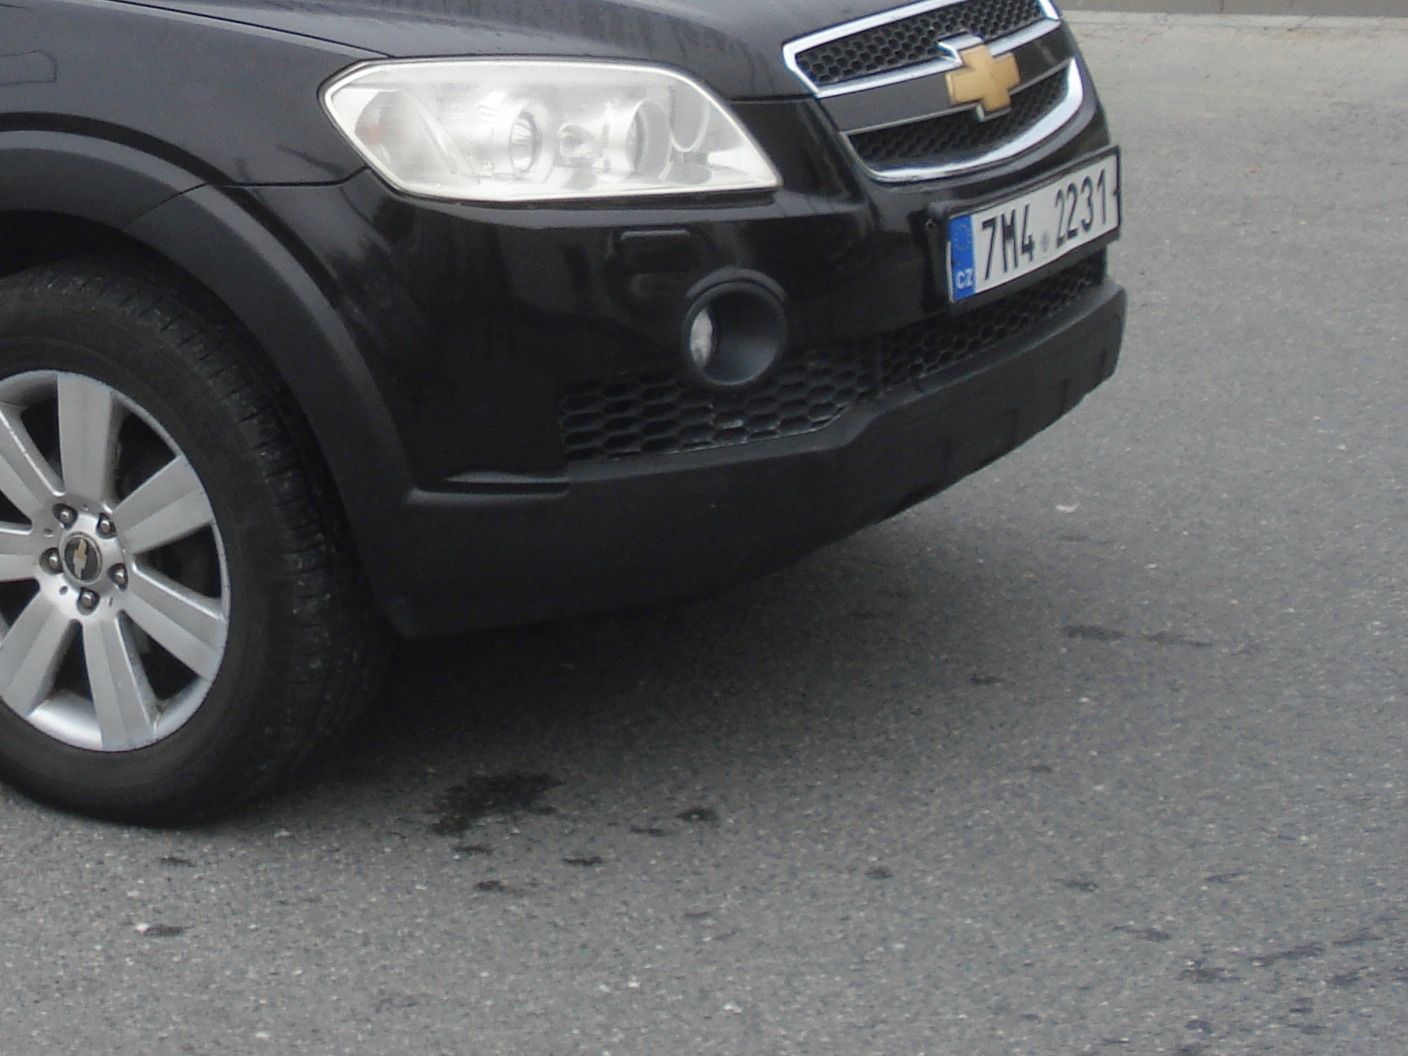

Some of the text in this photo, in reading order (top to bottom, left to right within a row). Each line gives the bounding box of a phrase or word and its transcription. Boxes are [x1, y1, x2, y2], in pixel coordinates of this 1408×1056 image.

[981, 168, 1107, 281] 7M4 2231
[954, 267, 975, 290] CZ
